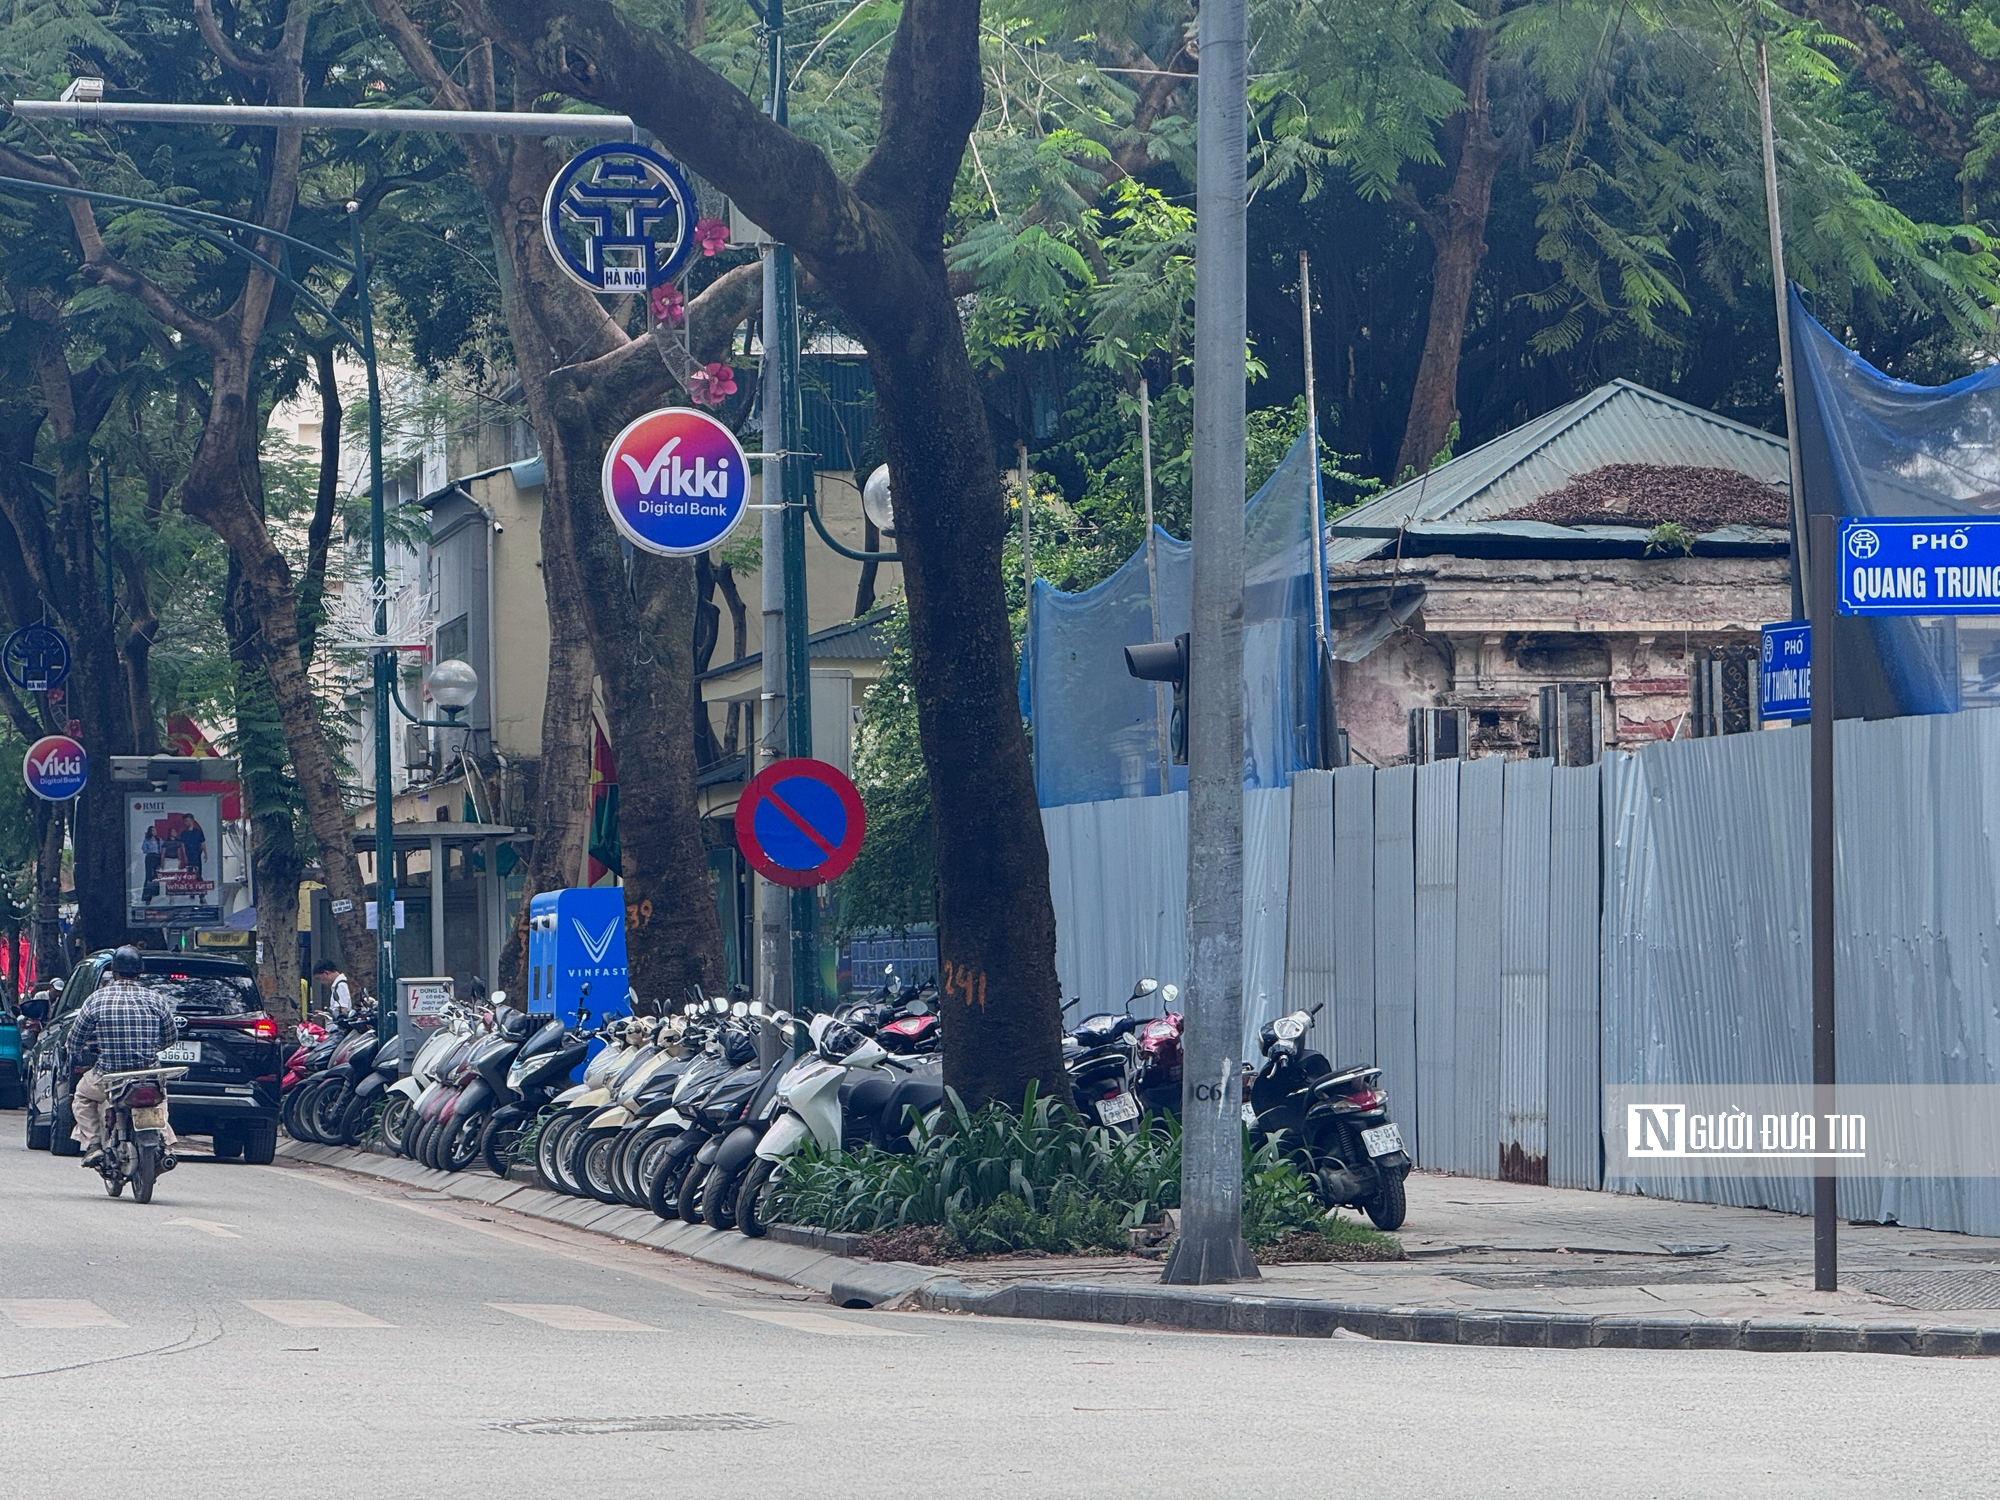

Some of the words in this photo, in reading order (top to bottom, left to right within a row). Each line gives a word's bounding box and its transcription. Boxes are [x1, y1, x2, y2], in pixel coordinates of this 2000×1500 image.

[605, 268, 622, 285] HÀ
[625, 268, 645, 289] NỘI
[620, 436, 729, 498] Vikki
[638, 500, 688, 517] Digital
[690, 502, 727, 517] Bank
[1912, 526, 1971, 550] PHỐ
[1853, 566, 1927, 602] QUANG
[1784, 632, 1805, 656] PHỐ
[1798, 661, 1811, 705] KIỆ
[30, 748, 81, 776] Vikki
[40, 777, 63, 785] Digital
[63, 776, 81, 784] Bank
[142, 802, 166, 810] RMIT
[568, 967, 628, 978] VINFAST
[943, 960, 987, 1012] 241
[161, 1050, 196, 1061] 386.03
